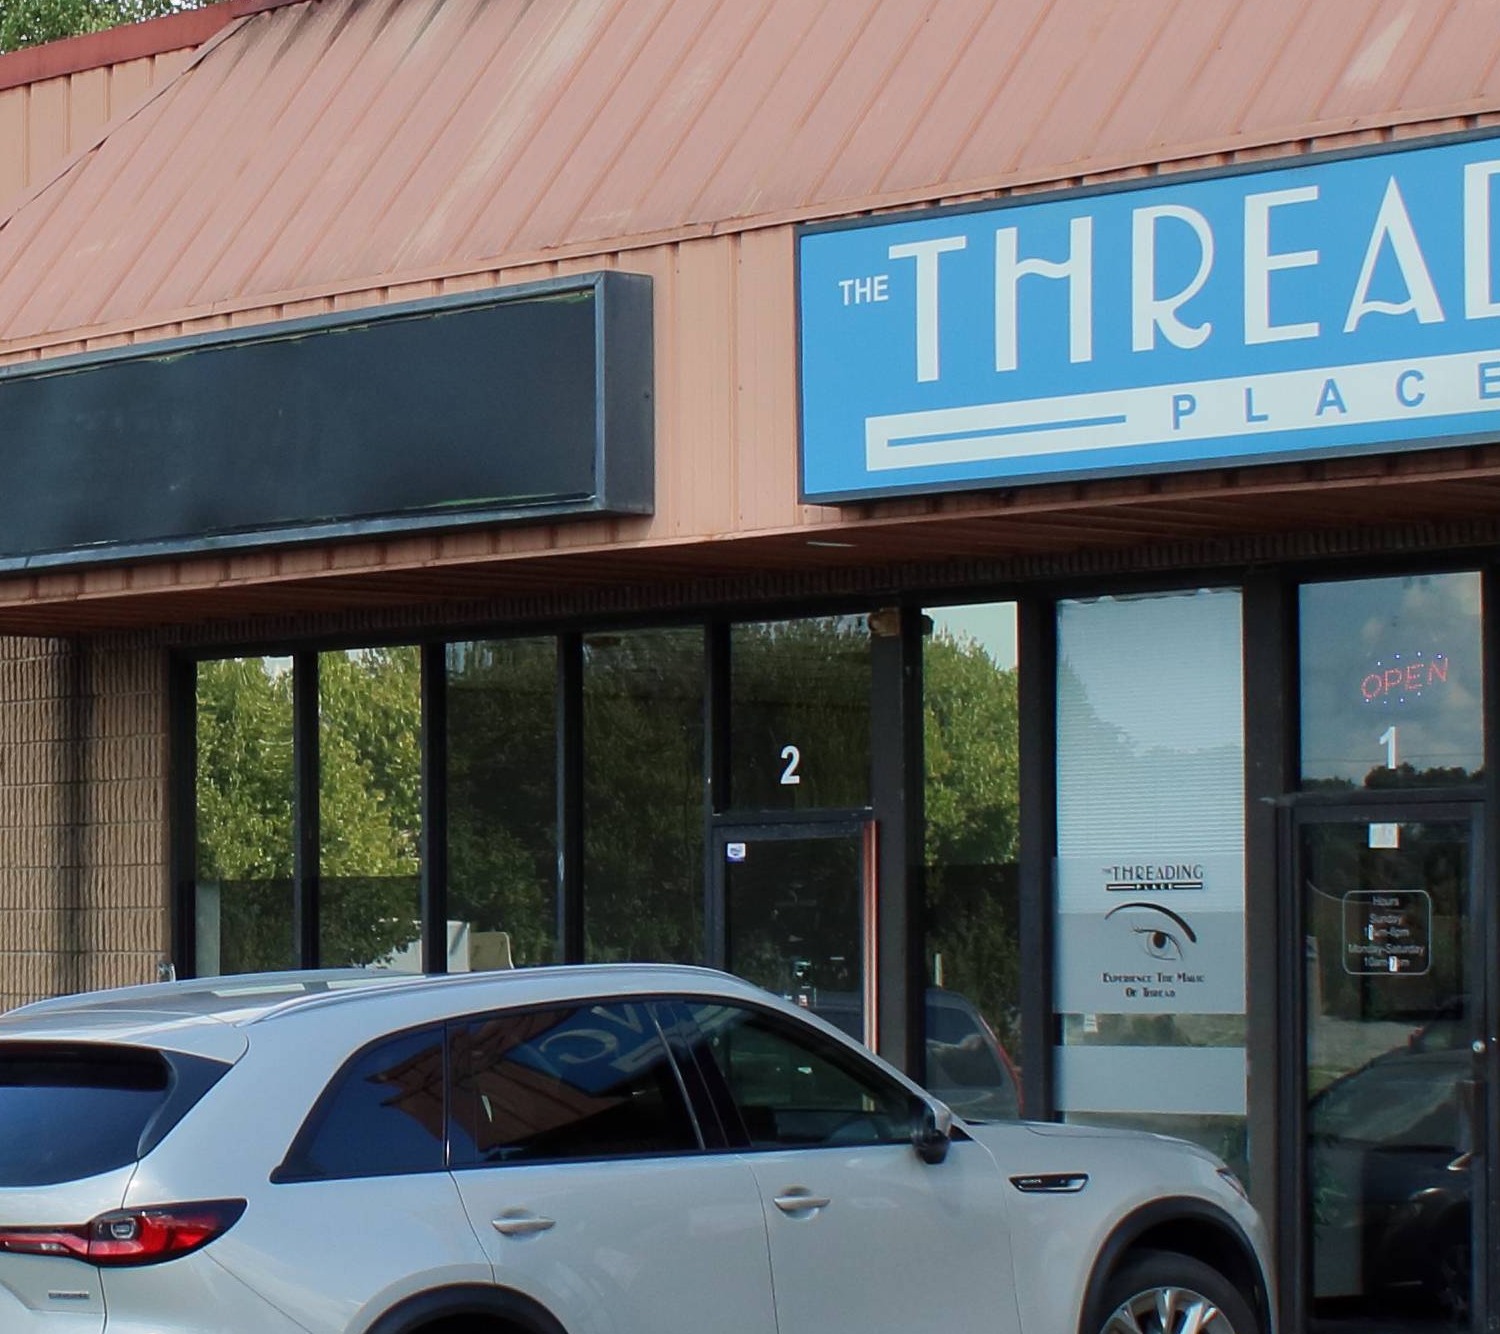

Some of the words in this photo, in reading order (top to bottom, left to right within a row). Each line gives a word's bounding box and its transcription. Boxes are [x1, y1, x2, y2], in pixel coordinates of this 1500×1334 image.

[839, 275, 889, 306] THE
[1361, 657, 1449, 699] OPEN
[780, 745, 800, 784] 2
[1379, 726, 1396, 769] 1
[1112, 865, 1203, 881] THREADING
